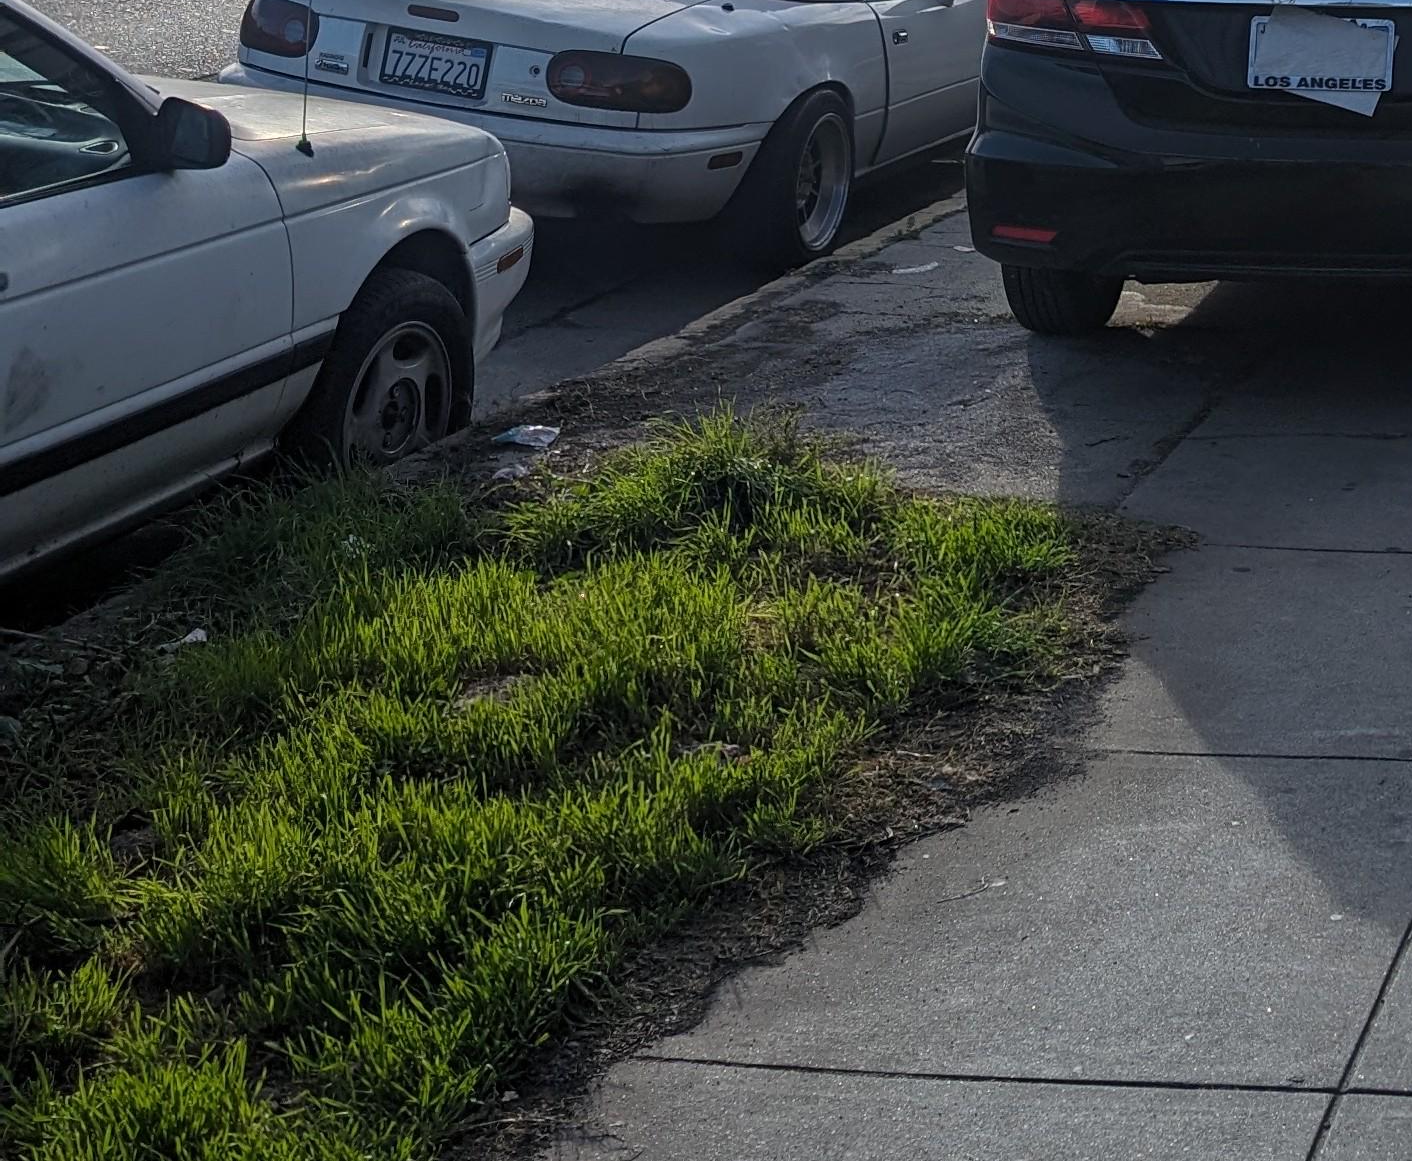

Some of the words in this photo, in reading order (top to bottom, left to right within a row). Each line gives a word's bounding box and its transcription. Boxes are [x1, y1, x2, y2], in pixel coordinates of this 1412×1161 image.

[390, 49, 481, 89] 7ZZE220
[1253, 75, 1292, 88] LOS
[1296, 77, 1387, 90] ANGELES
